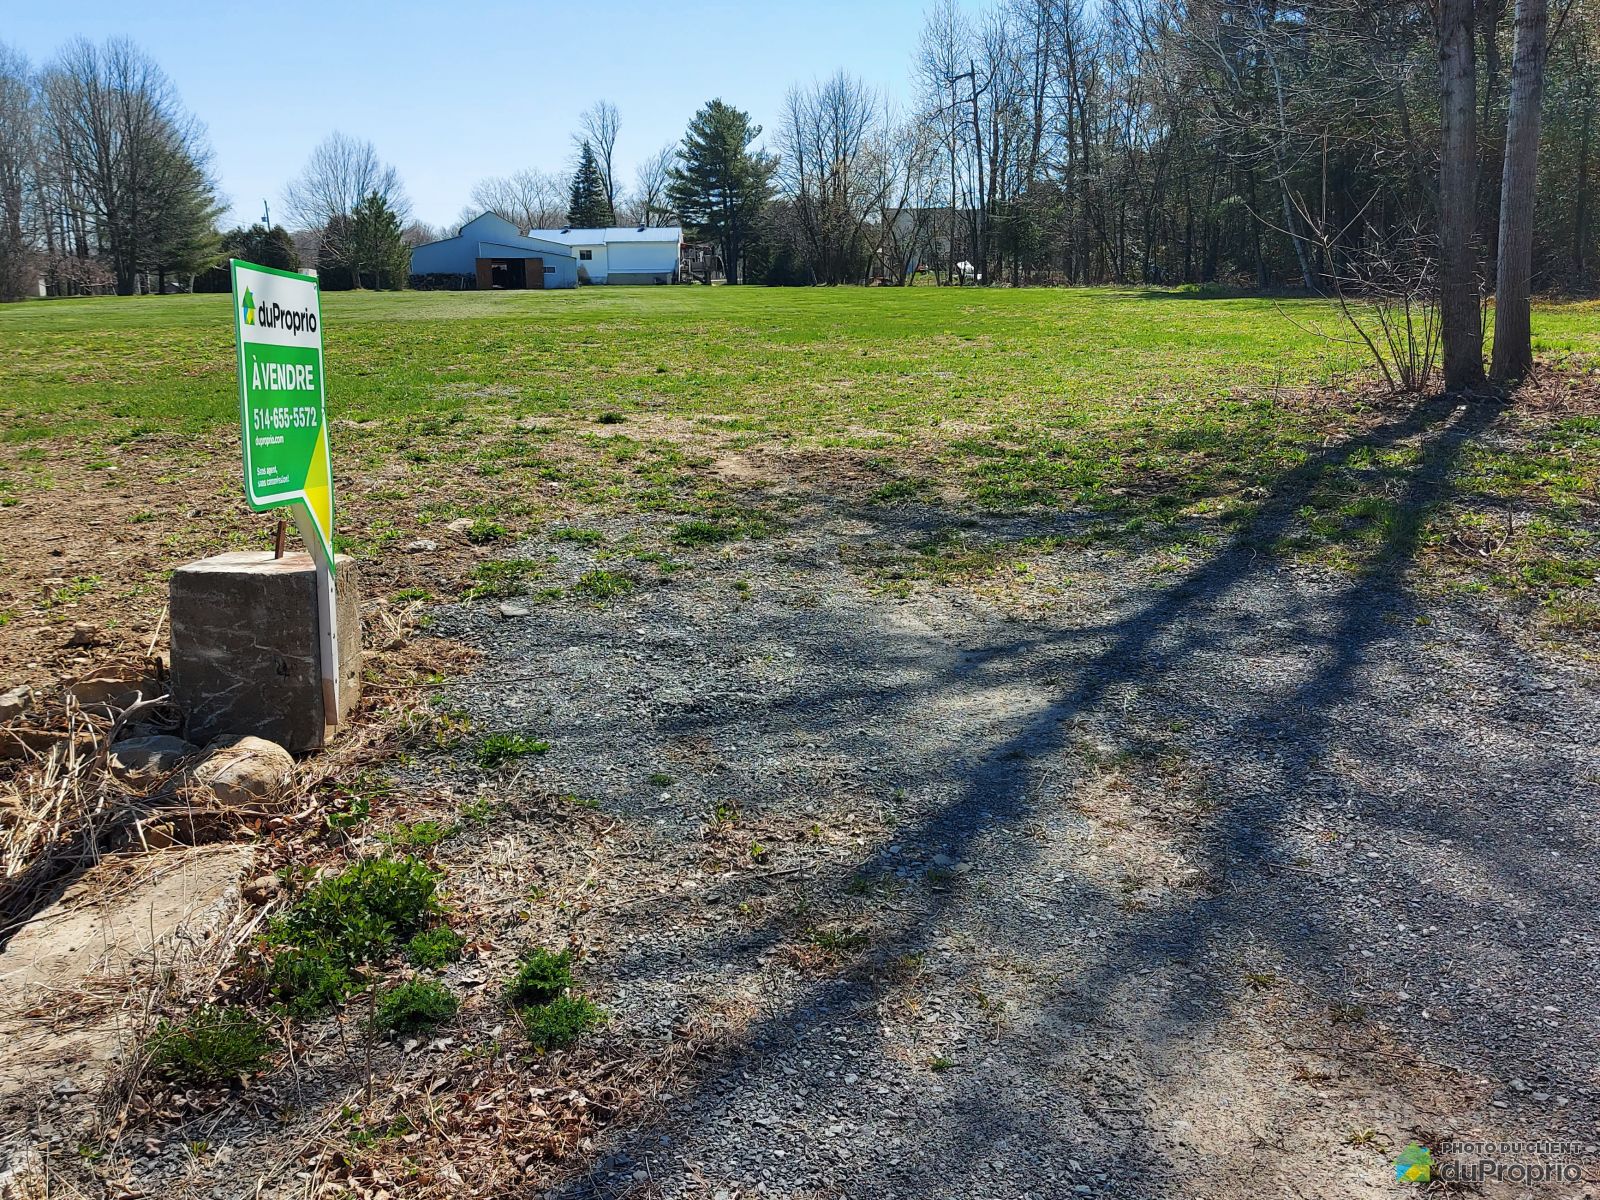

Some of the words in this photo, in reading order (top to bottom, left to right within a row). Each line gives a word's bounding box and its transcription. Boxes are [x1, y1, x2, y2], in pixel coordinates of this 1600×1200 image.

[258, 300, 317, 336] duProprio
[252, 354, 261, 391] À
[261, 362, 315, 391] VENDRE
